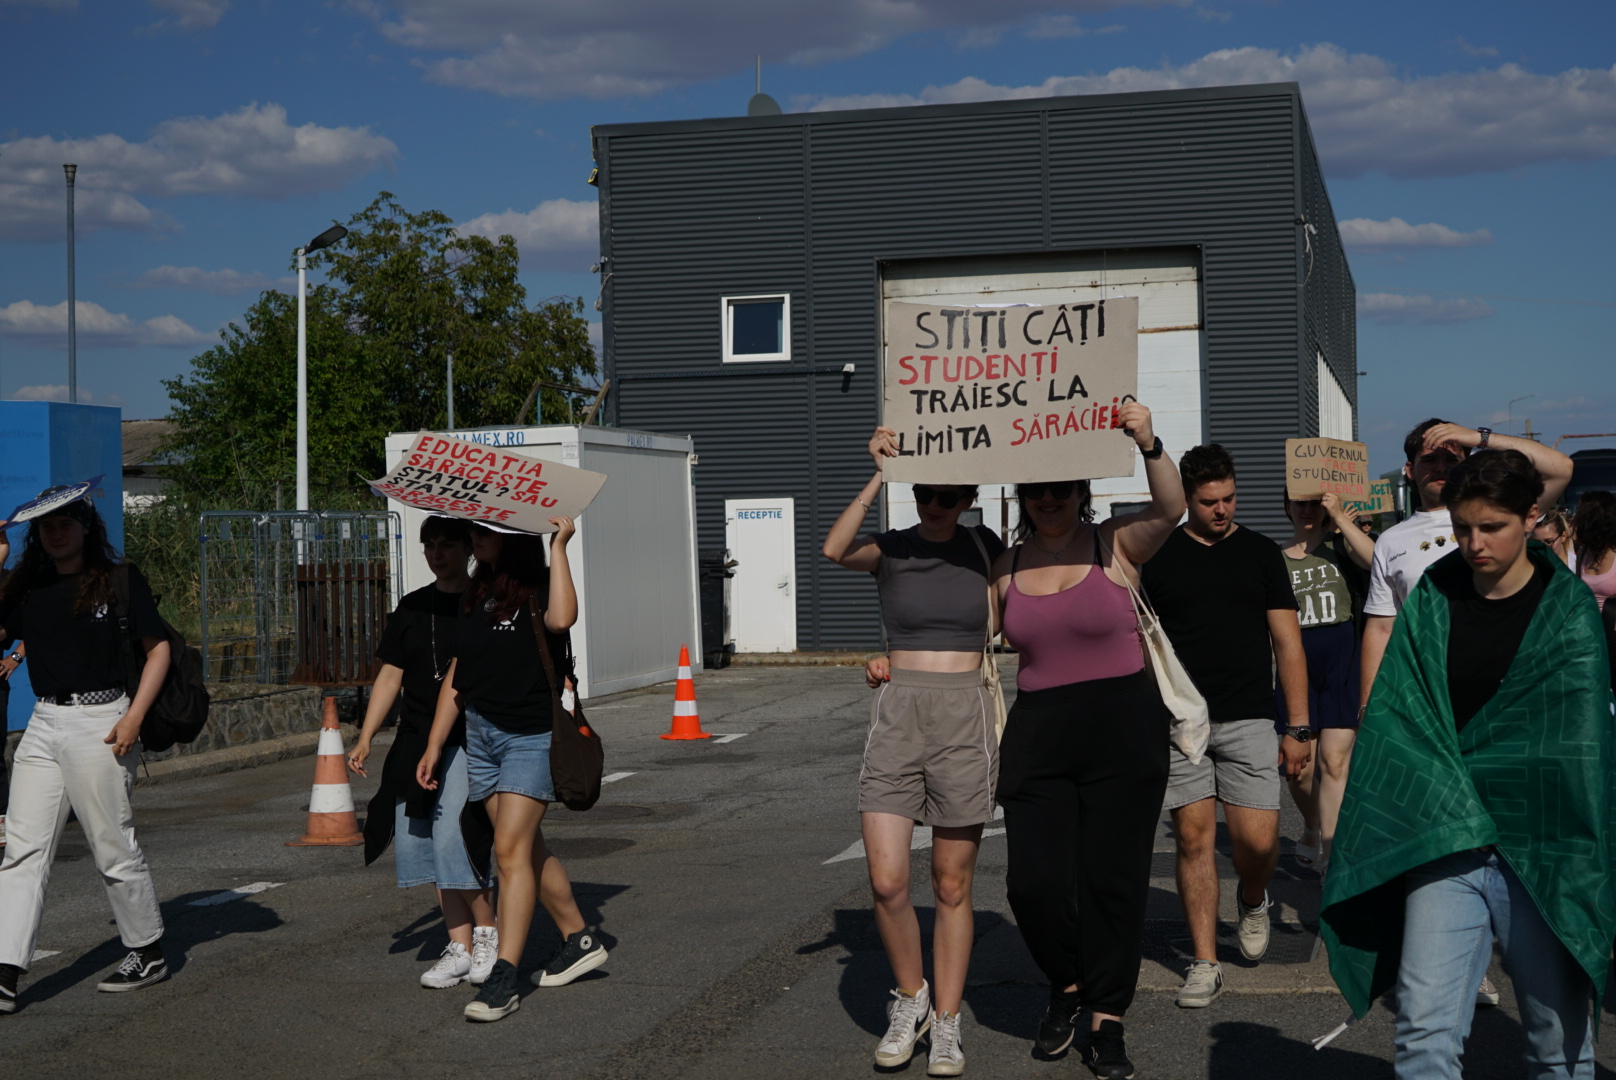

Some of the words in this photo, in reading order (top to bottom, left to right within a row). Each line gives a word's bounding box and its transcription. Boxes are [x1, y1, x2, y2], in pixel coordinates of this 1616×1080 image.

[1022, 299, 1106, 346] CÂȚI
[1048, 374, 1088, 402] LA
[898, 424, 991, 456] LIMITA
[1294, 444, 1367, 463] GUVERNUL
[1317, 458, 1358, 473] TACE
[387, 476, 482, 503] STATUL
[510, 491, 558, 508] SAU
[737, 510, 783, 520] RECEPTIE
[1292, 563, 1340, 585] ETTY
[1296, 590, 1337, 626] AD
